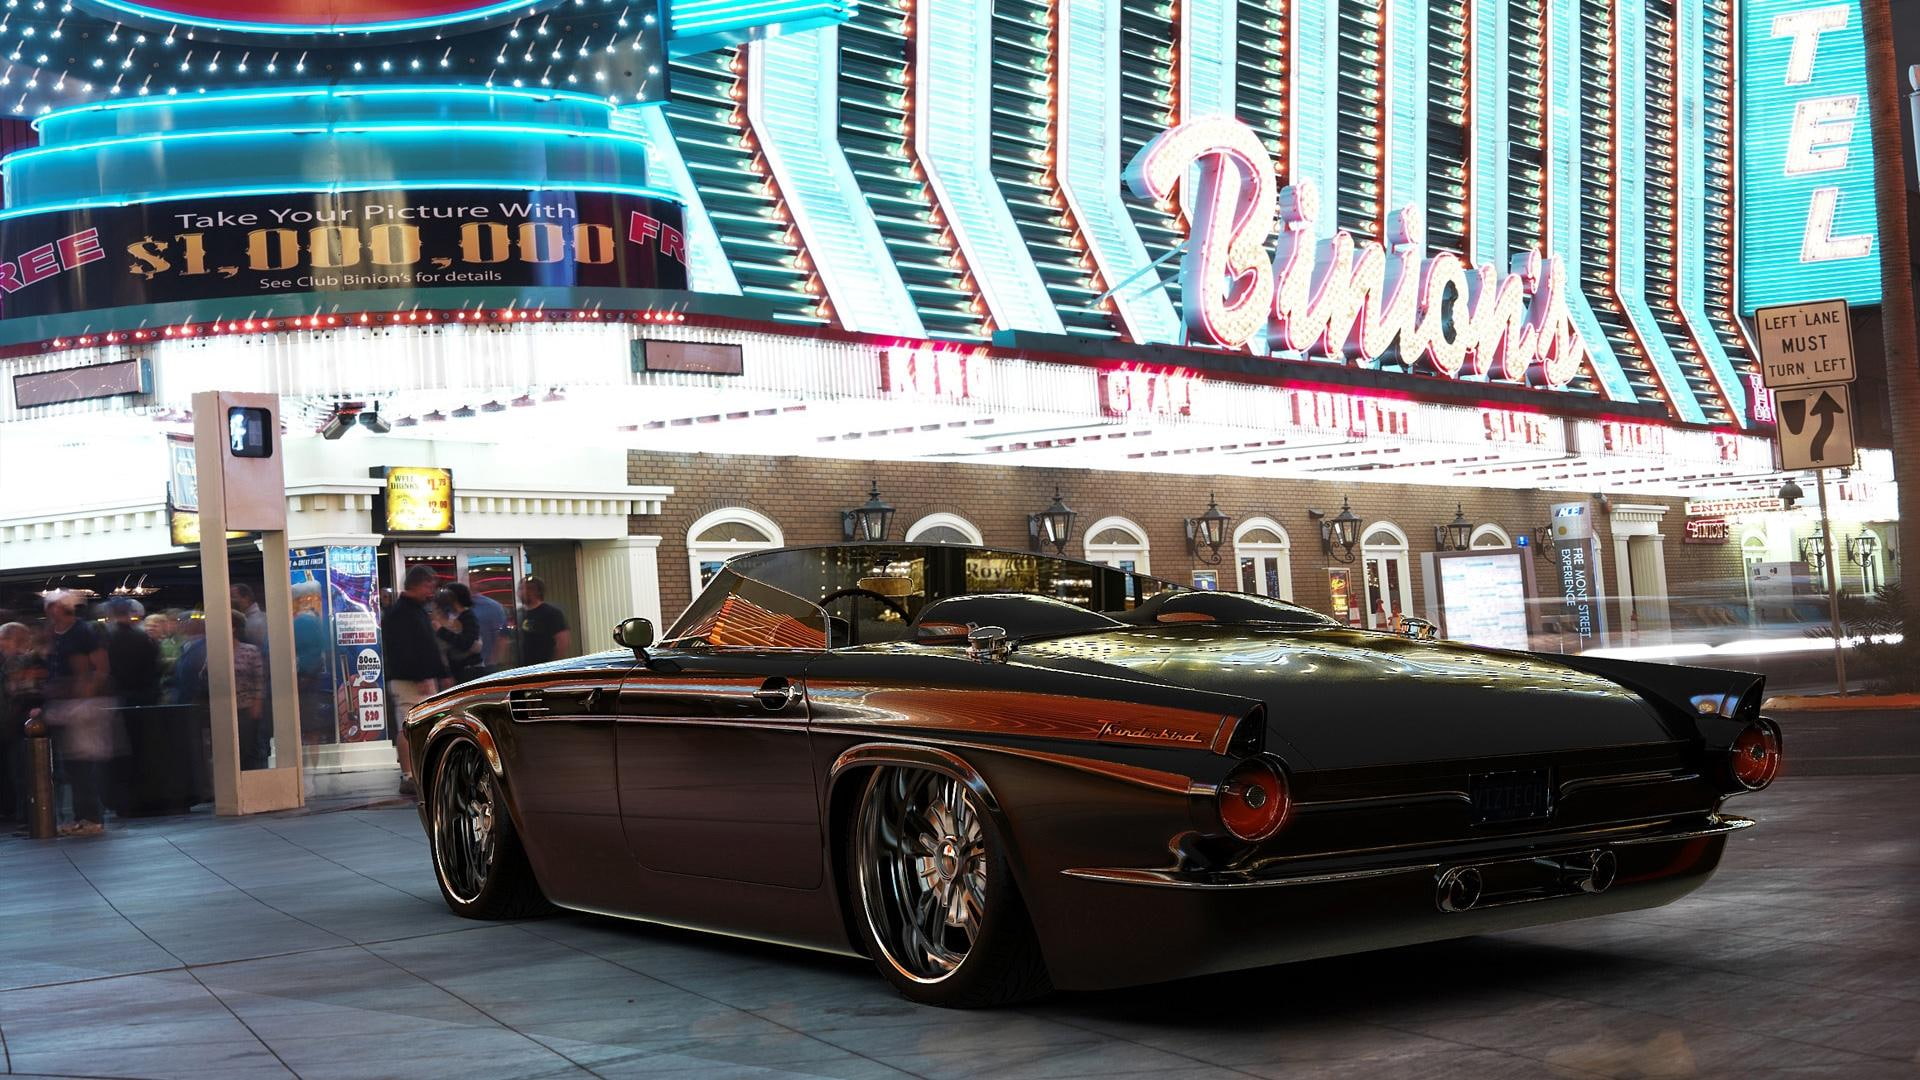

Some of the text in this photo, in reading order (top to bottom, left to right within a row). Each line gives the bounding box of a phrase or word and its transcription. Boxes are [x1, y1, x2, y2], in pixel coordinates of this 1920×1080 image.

[174, 202, 576, 230] Take Your Picture With
[126, 222, 616, 281] $1,000,000
[1124, 114, 1586, 389] Binion's
[259, 269, 502, 289] See Club Binion's for details
[1764, 310, 1840, 330] LEFT LANE
[1781, 334, 1828, 354] MUST
[1768, 357, 1847, 377] TURN LEFT
[1690, 500, 1780, 514] ENTRANCE
[1689, 523, 1730, 538] BINION'S
[1561, 548, 1576, 607] EXPERIENCE
[1578, 604, 1592, 639] STREET
[358, 655, 379, 664] 80oz.
[363, 691, 378, 704] $15
[365, 710, 380, 722] $20
[1097, 719, 1203, 743] Thunderbird
